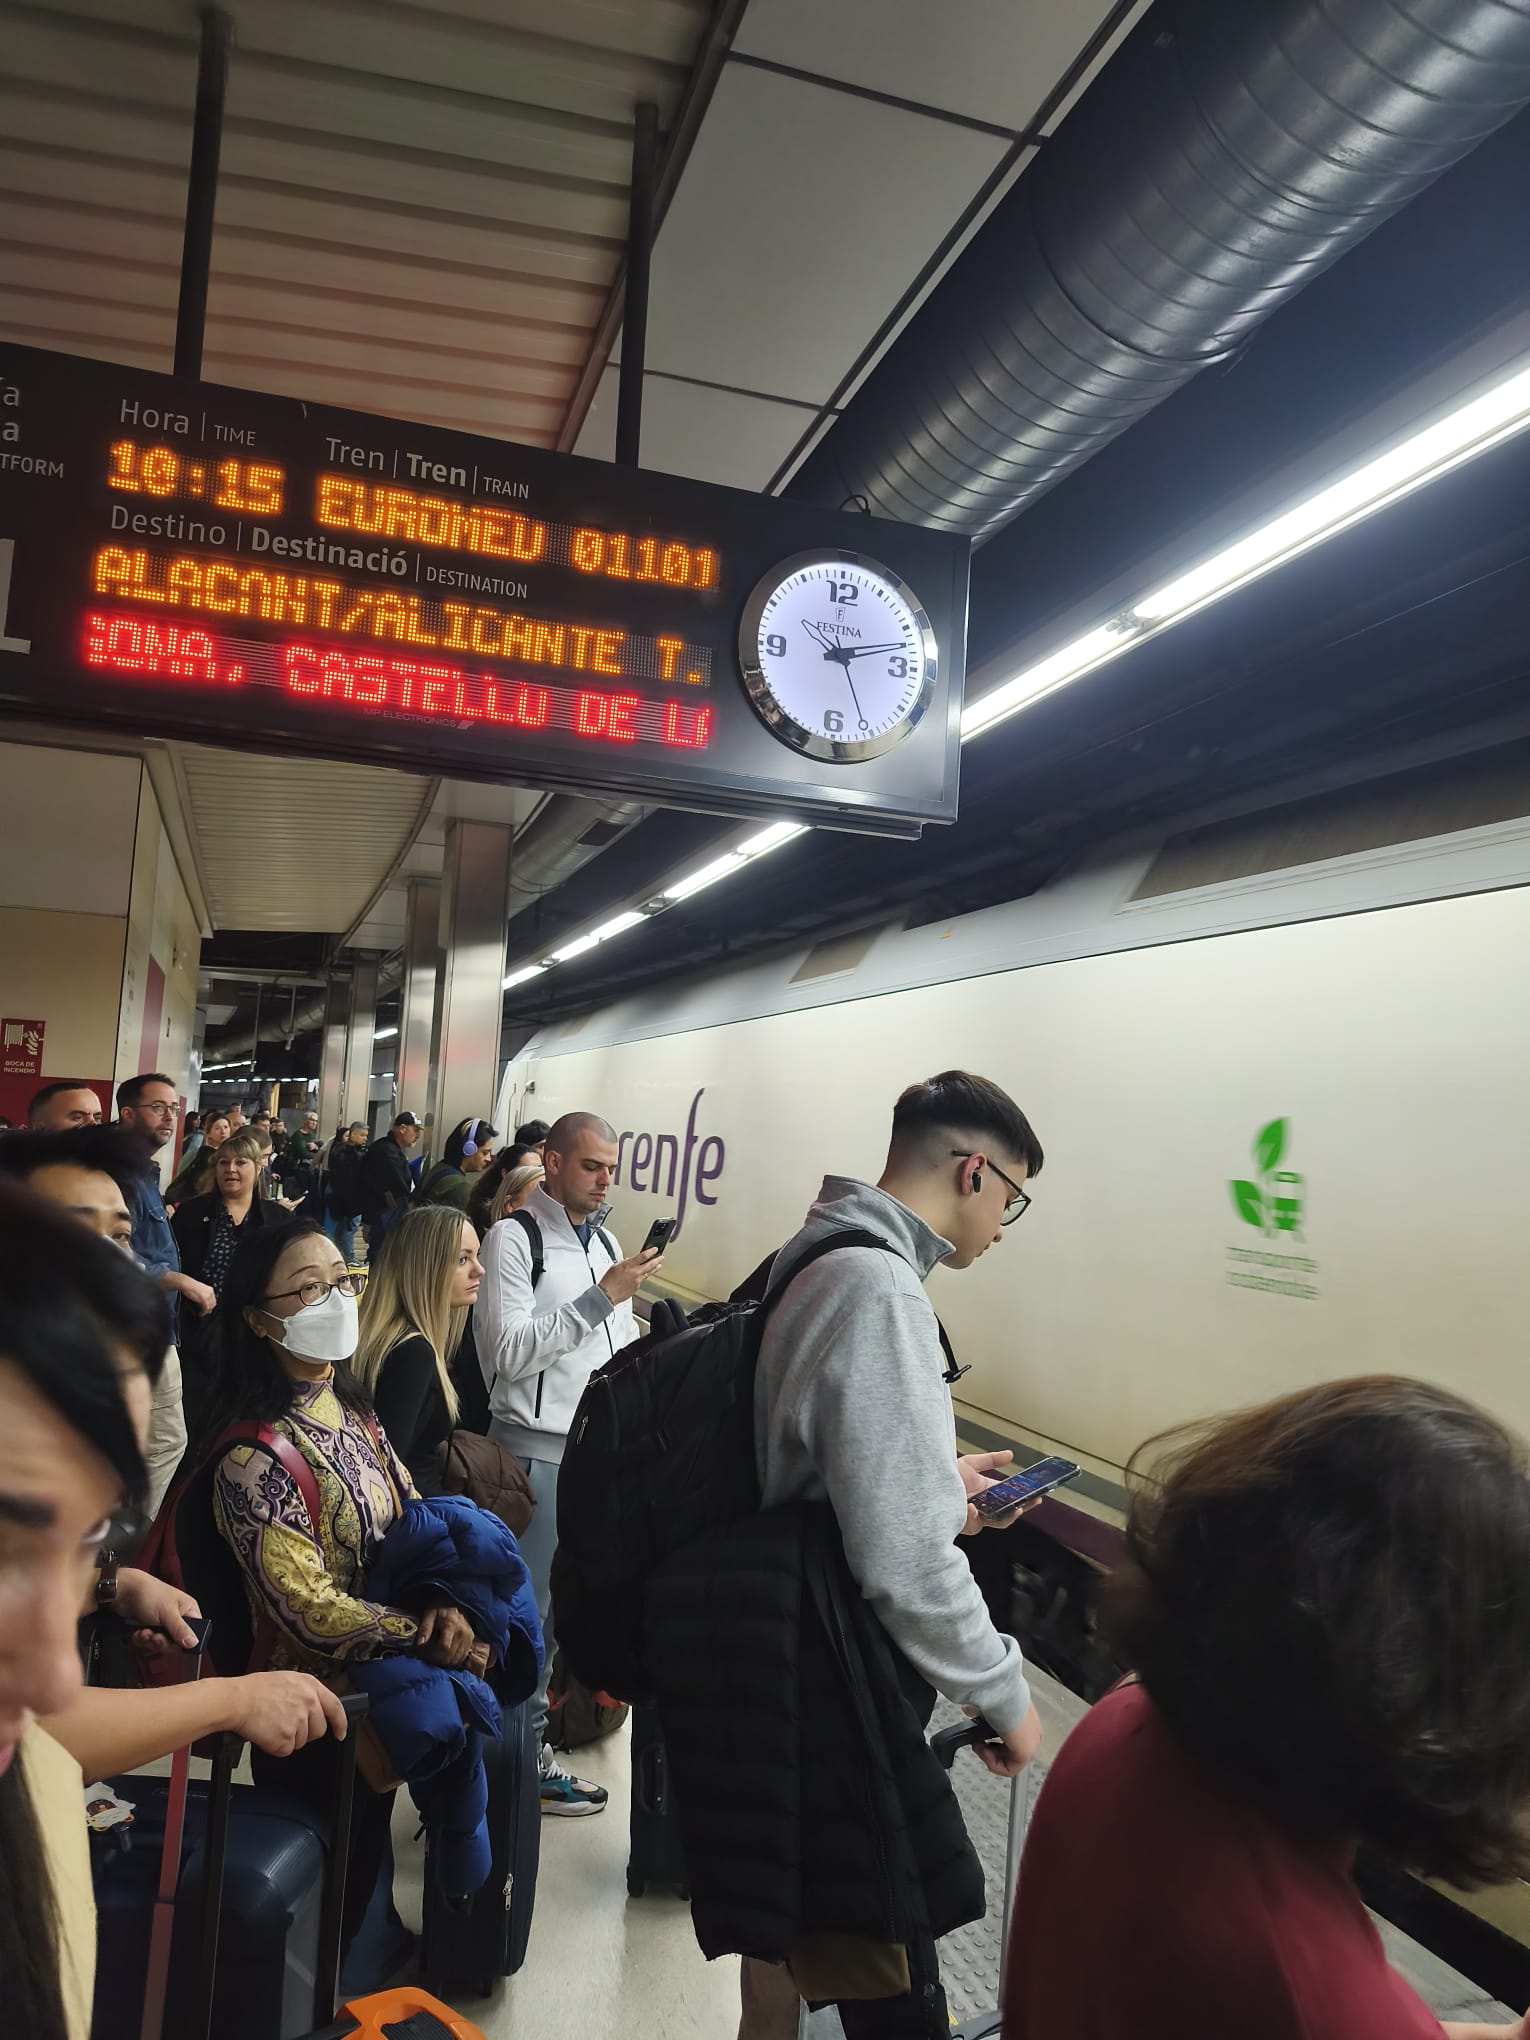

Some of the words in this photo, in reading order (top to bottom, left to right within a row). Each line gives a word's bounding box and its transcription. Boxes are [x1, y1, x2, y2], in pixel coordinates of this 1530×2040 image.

[120, 399, 190, 435] Hora
[214, 424, 257, 447] TIME
[109, 441, 283, 514] 10:15
[326, 437, 385, 472] Tren
[406, 452, 467, 488] Tren
[483, 476, 530, 499] TRAIN
[111, 505, 227, 546] Destino
[251, 526, 408, 577] Destinació
[426, 565, 529, 600] DESTINATION
[319, 478, 545, 561] EUROMED
[573, 529, 713, 588] 01101
[95, 547, 626, 675] ALACANT/ALICANTE
[658, 638, 702, 685] T.
[826, 579, 859, 607] 12
[766, 633, 787, 658] 9
[816, 621, 862, 639] FESTINA
[887, 656, 908, 679] 3
[383, 710, 457, 728] ELECTRONICS
[577, 693, 639, 740] DE
[823, 710, 845, 733] 6
[3, 1066, 36, 1074] INCENDIO
[613, 1087, 726, 1244] renfe
